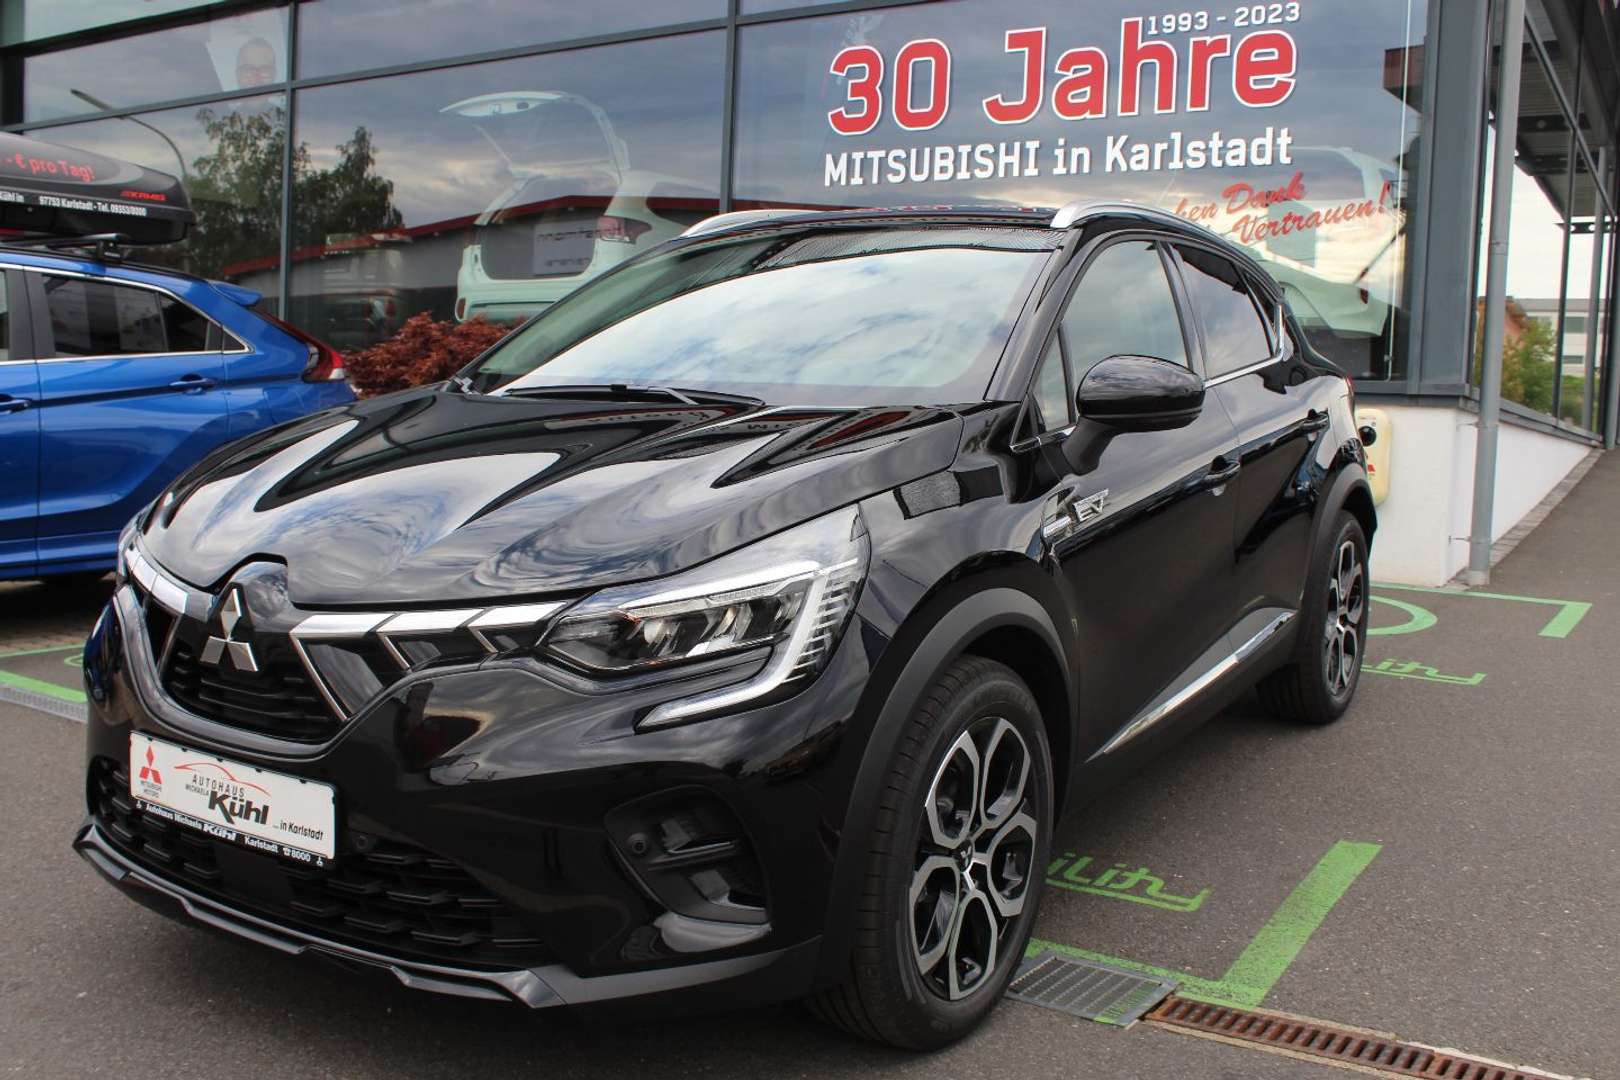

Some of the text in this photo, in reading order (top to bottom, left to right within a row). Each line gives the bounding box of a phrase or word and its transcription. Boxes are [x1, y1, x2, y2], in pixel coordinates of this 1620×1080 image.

[1147, 11, 1209, 35] 1993
[1233, 2, 1301, 28] 2023
[827, 16, 1299, 136] 30 Jahre
[28, 158, 58, 176] pro
[824, 126, 1294, 187] MITSUBISHI in Karlstadt
[61, 198, 93, 210] Karlstadt
[1221, 169, 1306, 215] Dank
[1231, 180, 1392, 244] Vertrauen!
[192, 775, 245, 796] AUTOHAUS
[208, 790, 269, 825] Kühl
[203, 823, 237, 841] Kühl
[244, 834, 279, 853] Karlstadt
[288, 821, 324, 840] Karlstadt
